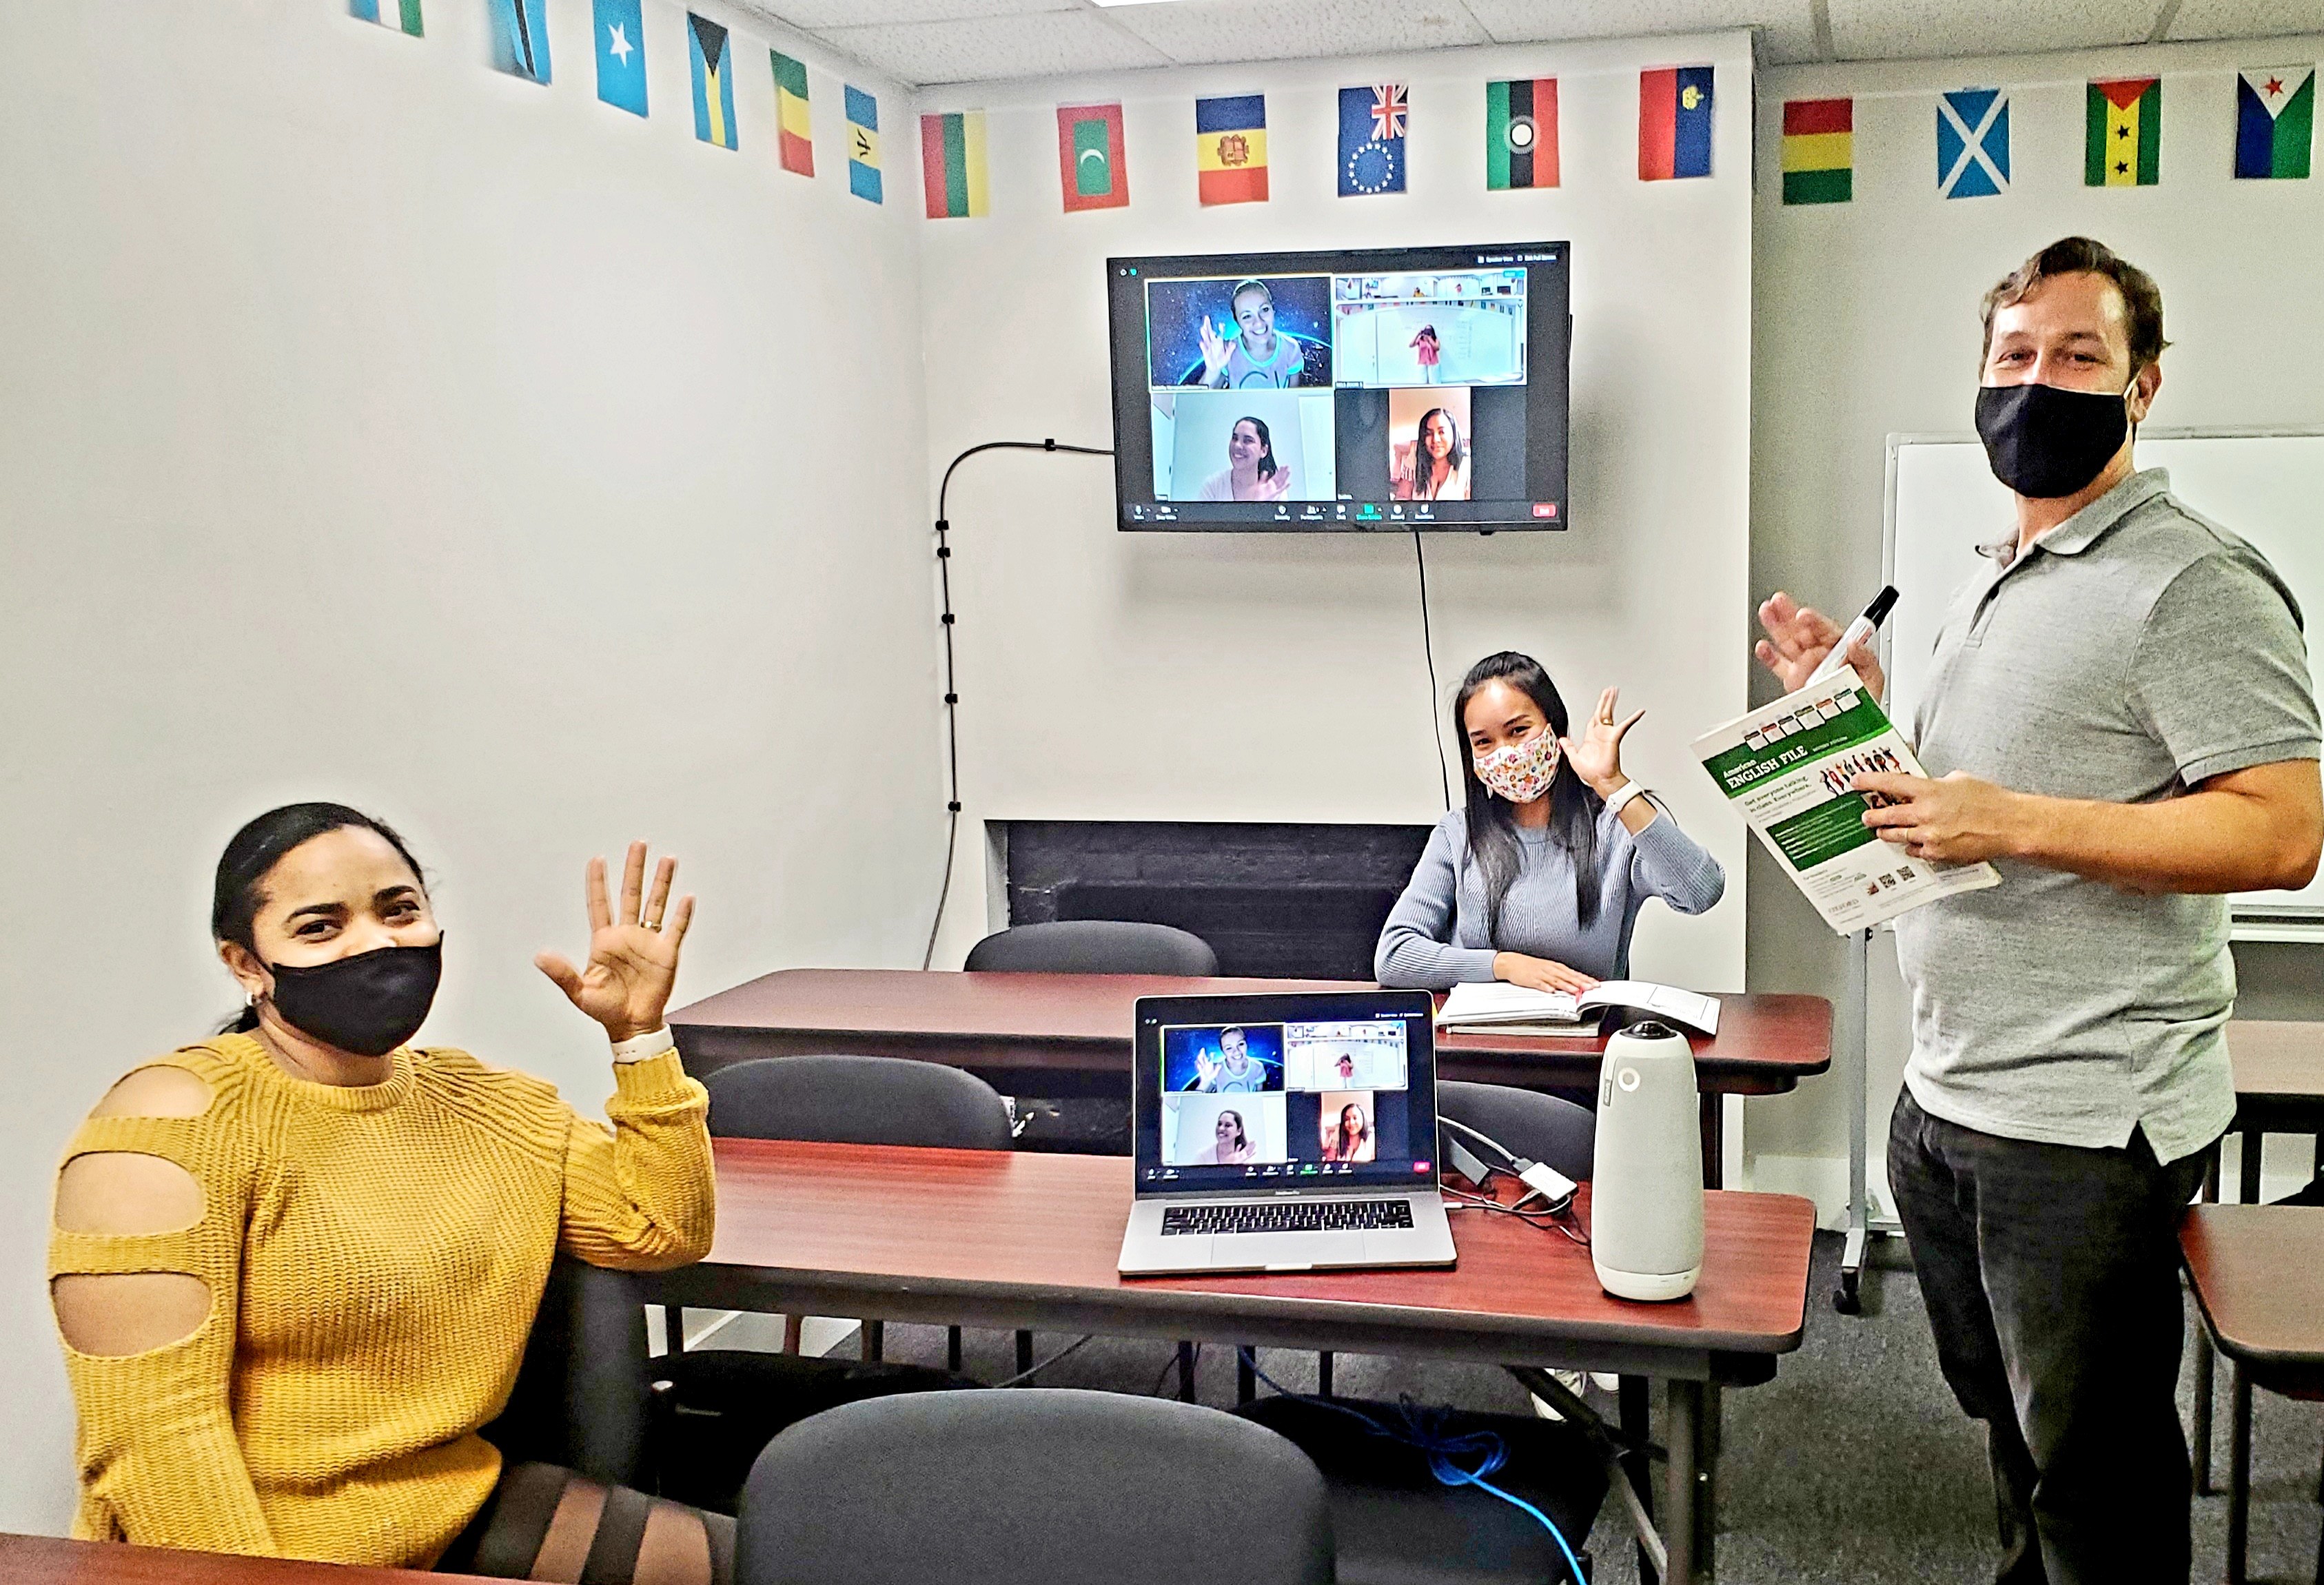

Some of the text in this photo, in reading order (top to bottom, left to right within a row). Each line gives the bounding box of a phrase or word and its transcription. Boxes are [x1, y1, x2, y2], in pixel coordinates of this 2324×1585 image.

[1723, 759, 1757, 778] American
[1726, 746, 1808, 789] ENGLISH FILE
